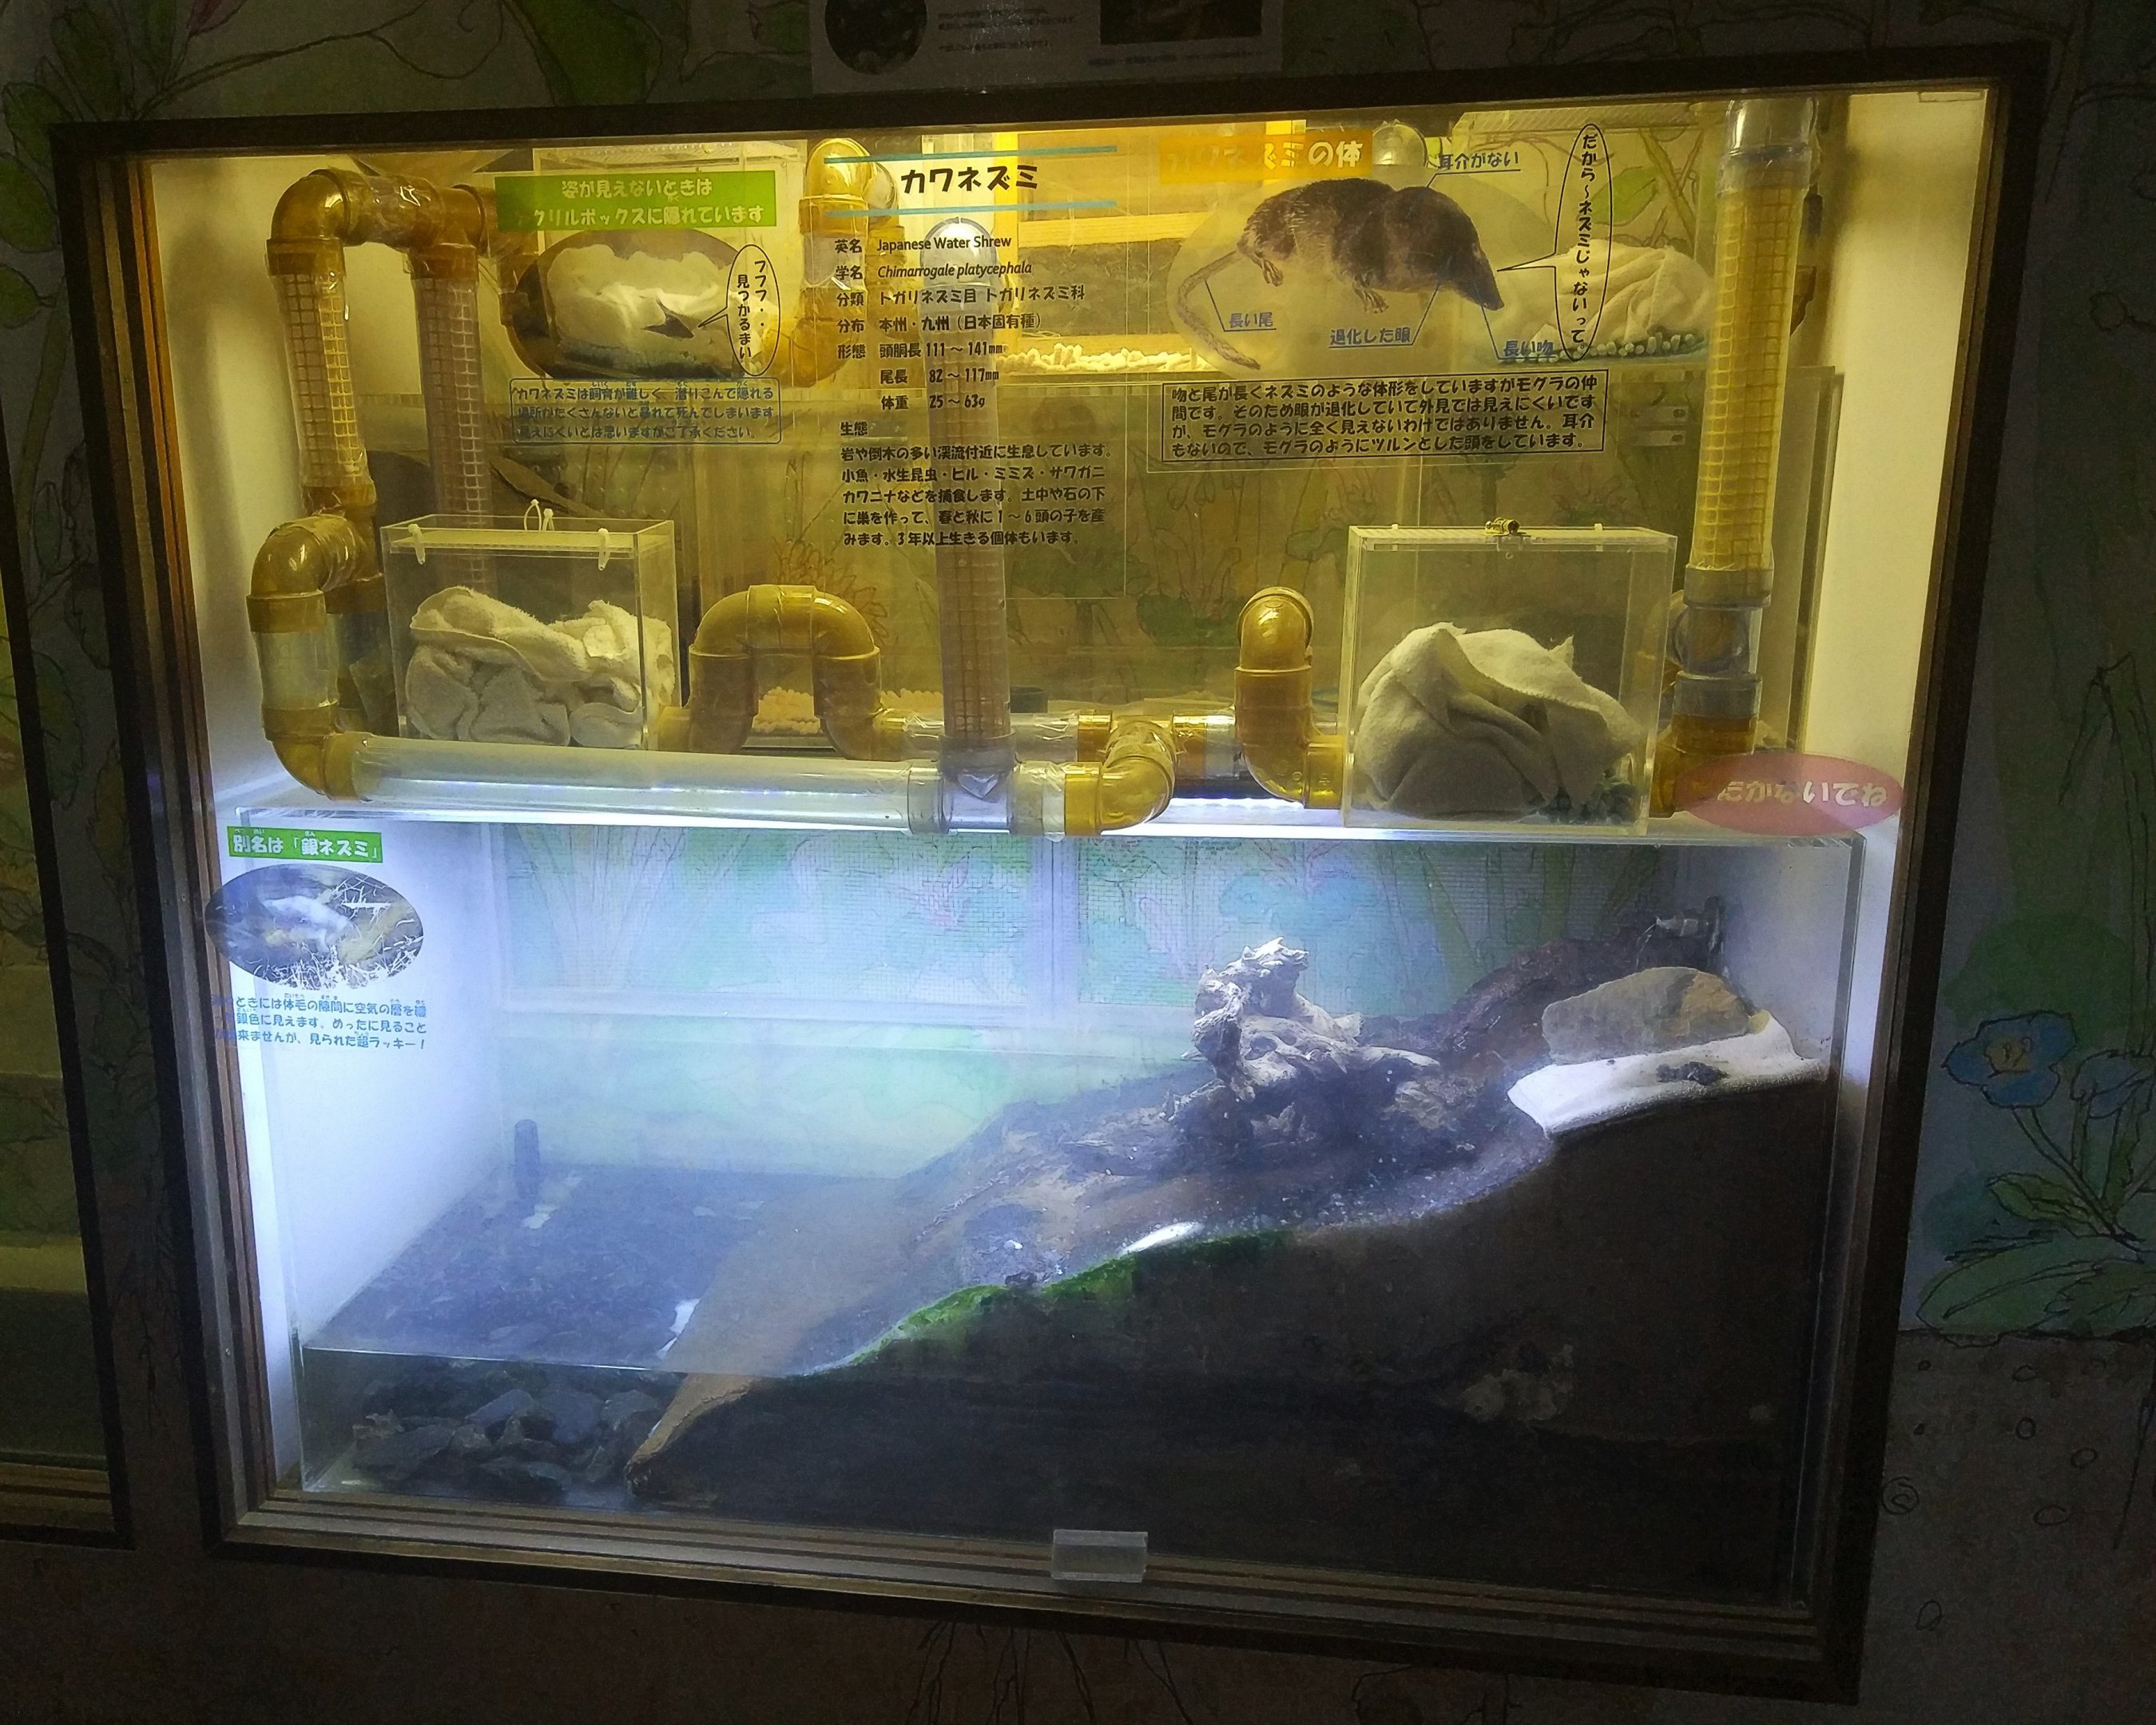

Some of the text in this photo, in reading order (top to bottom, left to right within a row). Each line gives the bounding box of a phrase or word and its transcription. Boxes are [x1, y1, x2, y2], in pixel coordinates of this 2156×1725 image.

[1439, 152, 1518, 169] 耳介がない
[562, 178, 713, 199] 姿が見えないときは
[901, 165, 1038, 194] カワネズミ
[519, 204, 764, 228] クリルボックスに隠れています
[835, 235, 1012, 253] 英名 Japanese Water Shrew
[836, 261, 1032, 281] 学名 Chimarrogale platycephala
[836, 285, 1086, 307] 分類 トガリネズミ目 トガリネズミ科
[737, 274, 752, 359] 見つかるまい
[837, 318, 865, 333] 分布
[1229, 311, 1273, 329] 長い尾
[1330, 327, 1411, 345] 退化した眼
[837, 344, 866, 359] 形態
[879, 343, 921, 359] 頭胴長
[880, 370, 907, 384] 尾長
[881, 395, 908, 410] 体重
[840, 422, 868, 436] 生態
[1718, 779, 1887, 807] たかないでね
[233, 835, 378, 859] 別名は「銀ネズミ」
